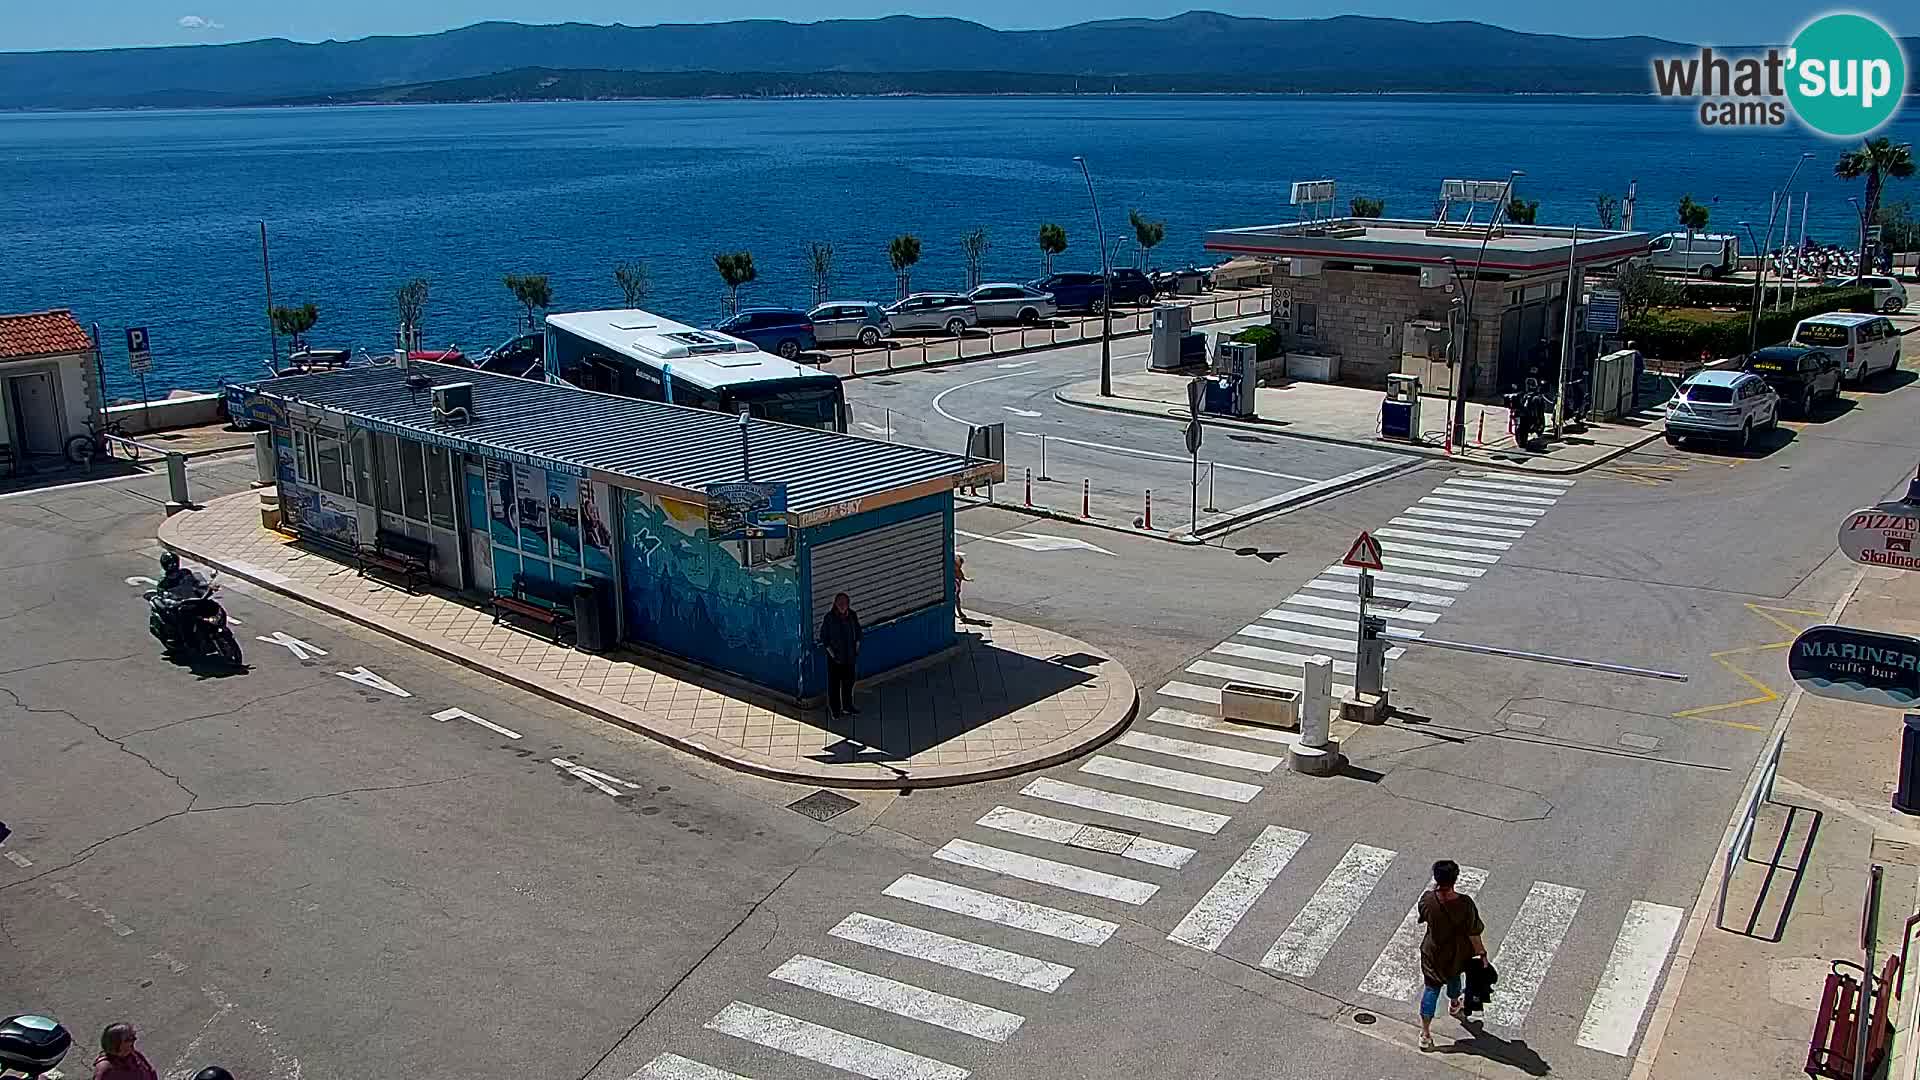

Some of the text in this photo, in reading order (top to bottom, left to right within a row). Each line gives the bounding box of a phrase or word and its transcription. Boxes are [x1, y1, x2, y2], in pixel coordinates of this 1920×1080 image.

[131, 331, 143, 348] P
[437, 436, 469, 452] POSTAJA
[479, 446, 494, 458] BUS
[495, 449, 526, 465] STATION
[528, 457, 555, 471] TICKET
[556, 462, 584, 477] OFFICE
[1882, 530, 1917, 539] GRILL
[1802, 641, 1920, 671] MARINER
[1829, 662, 1898, 679] caffe bar
